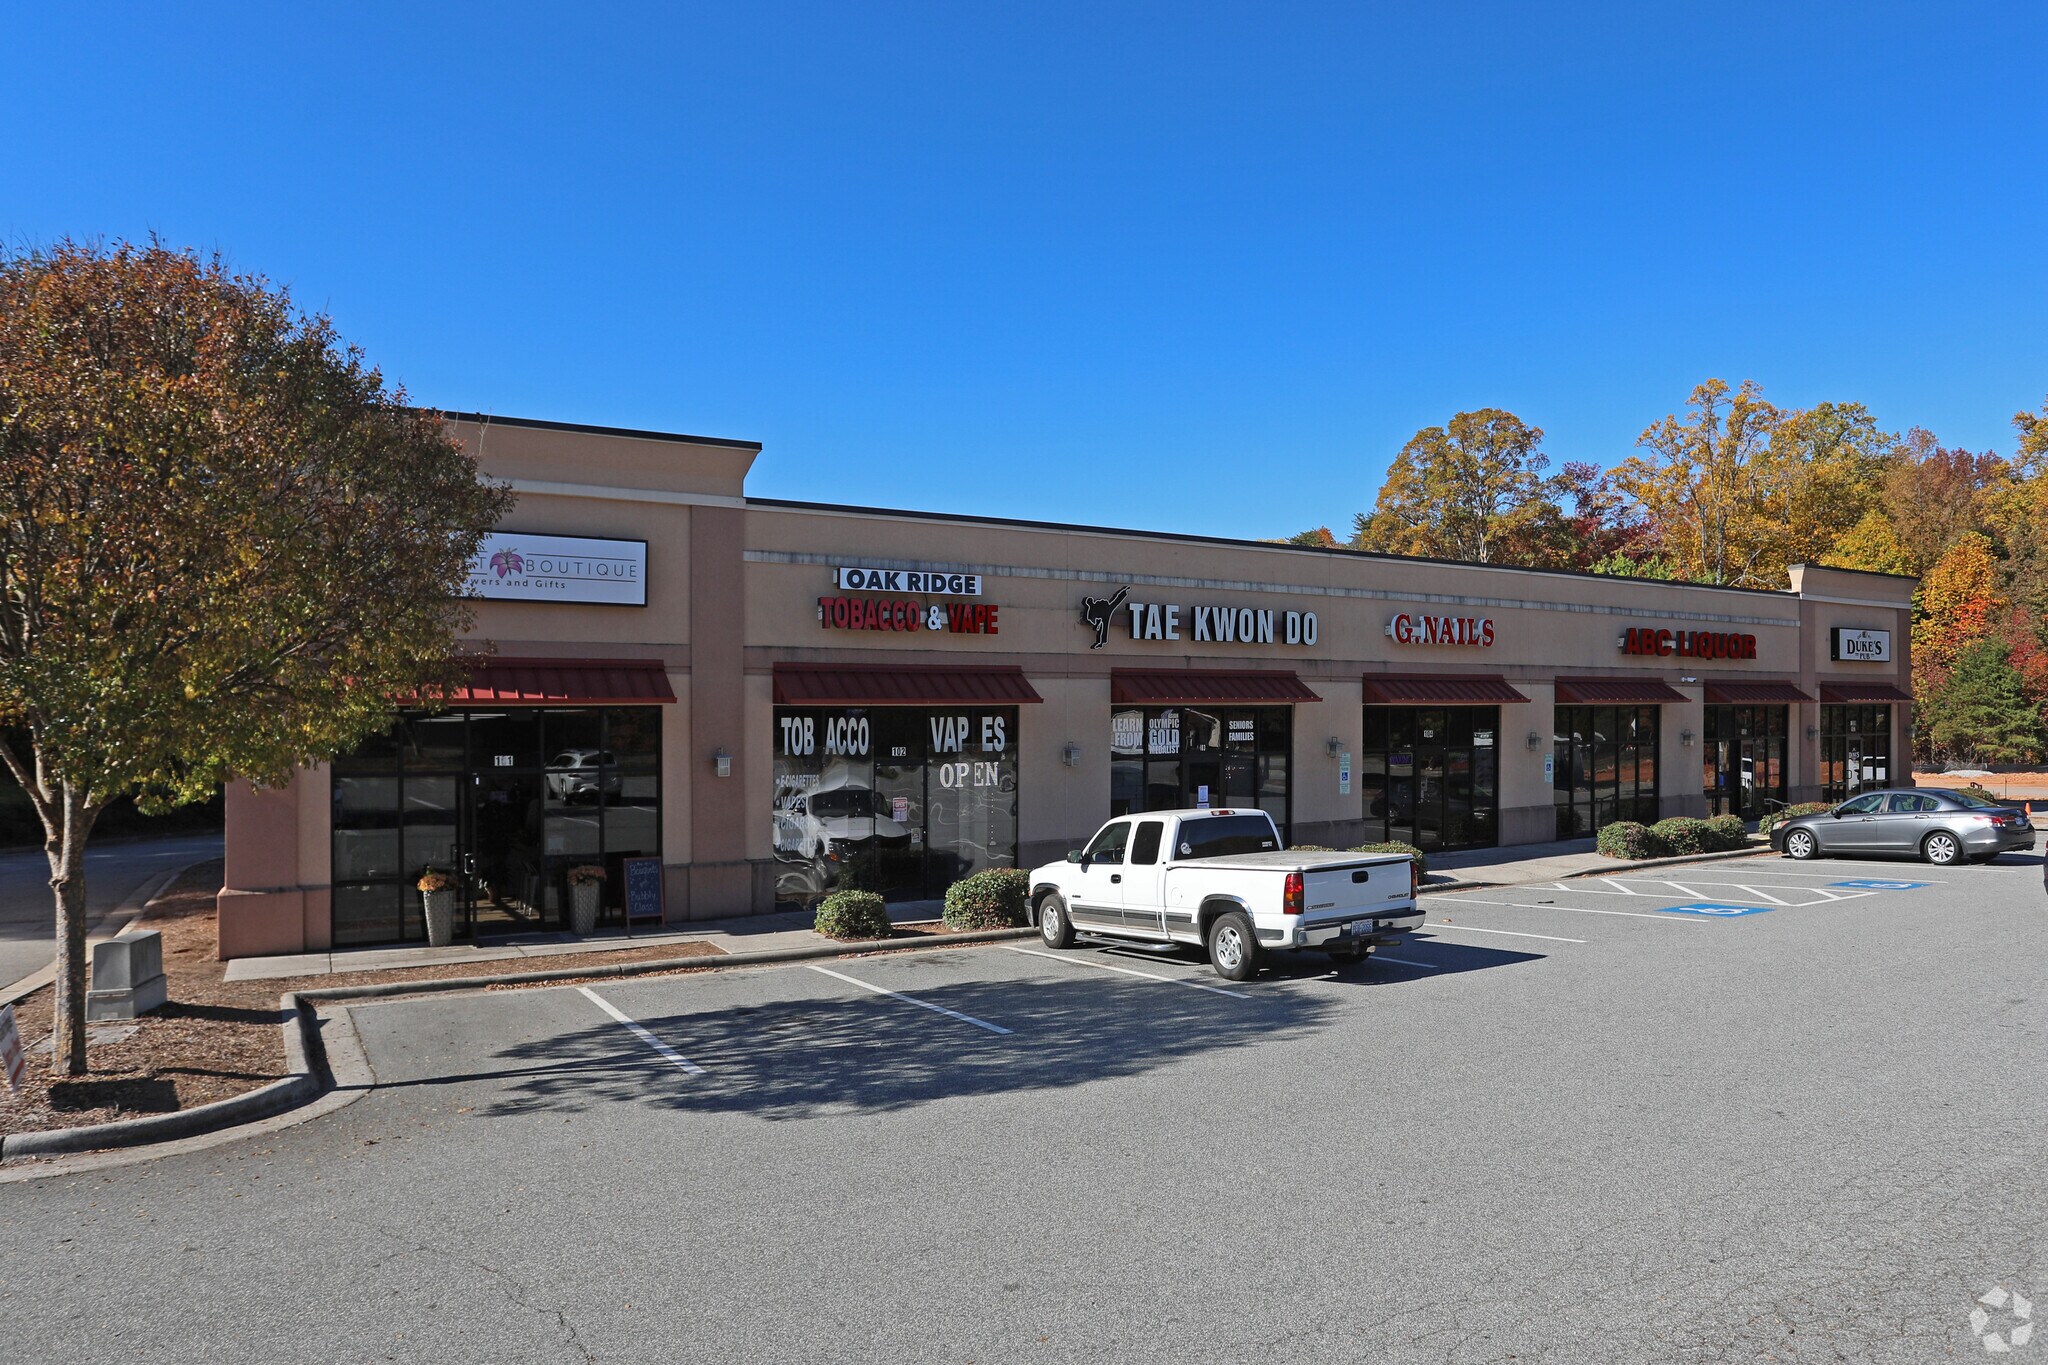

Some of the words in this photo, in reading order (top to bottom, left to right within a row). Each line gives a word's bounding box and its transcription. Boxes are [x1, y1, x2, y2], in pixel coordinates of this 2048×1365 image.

[526, 559, 637, 578] BOUTIQUE
[462, 577, 500, 586] owers
[506, 579, 529, 587] and
[535, 580, 566, 589] Gifts
[846, 568, 901, 591] OAK
[907, 571, 976, 594] RIDGE
[819, 596, 920, 632] TOBACCO
[927, 605, 942, 630] &
[947, 602, 998, 634] VAPE
[1126, 603, 1180, 641] TAE
[1191, 606, 1274, 644] KWON
[1282, 610, 1318, 646] DO
[1391, 613, 1495, 647] G.NAILS
[1622, 627, 1673, 657] ABC
[1676, 630, 1757, 660] LIQUOR
[1847, 639, 1882, 655] DUKE'S
[1113, 718, 1143, 731] LEARN
[1149, 718, 1180, 728] OLYMPIC
[1229, 720, 1253, 730] SENIORS
[1115, 732, 1143, 746] FROM
[1149, 728, 1180, 746] GOLD
[1228, 731, 1254, 742] FAMILIES
[892, 747, 906, 756] 102
[939, 762, 999, 788] OPEN
